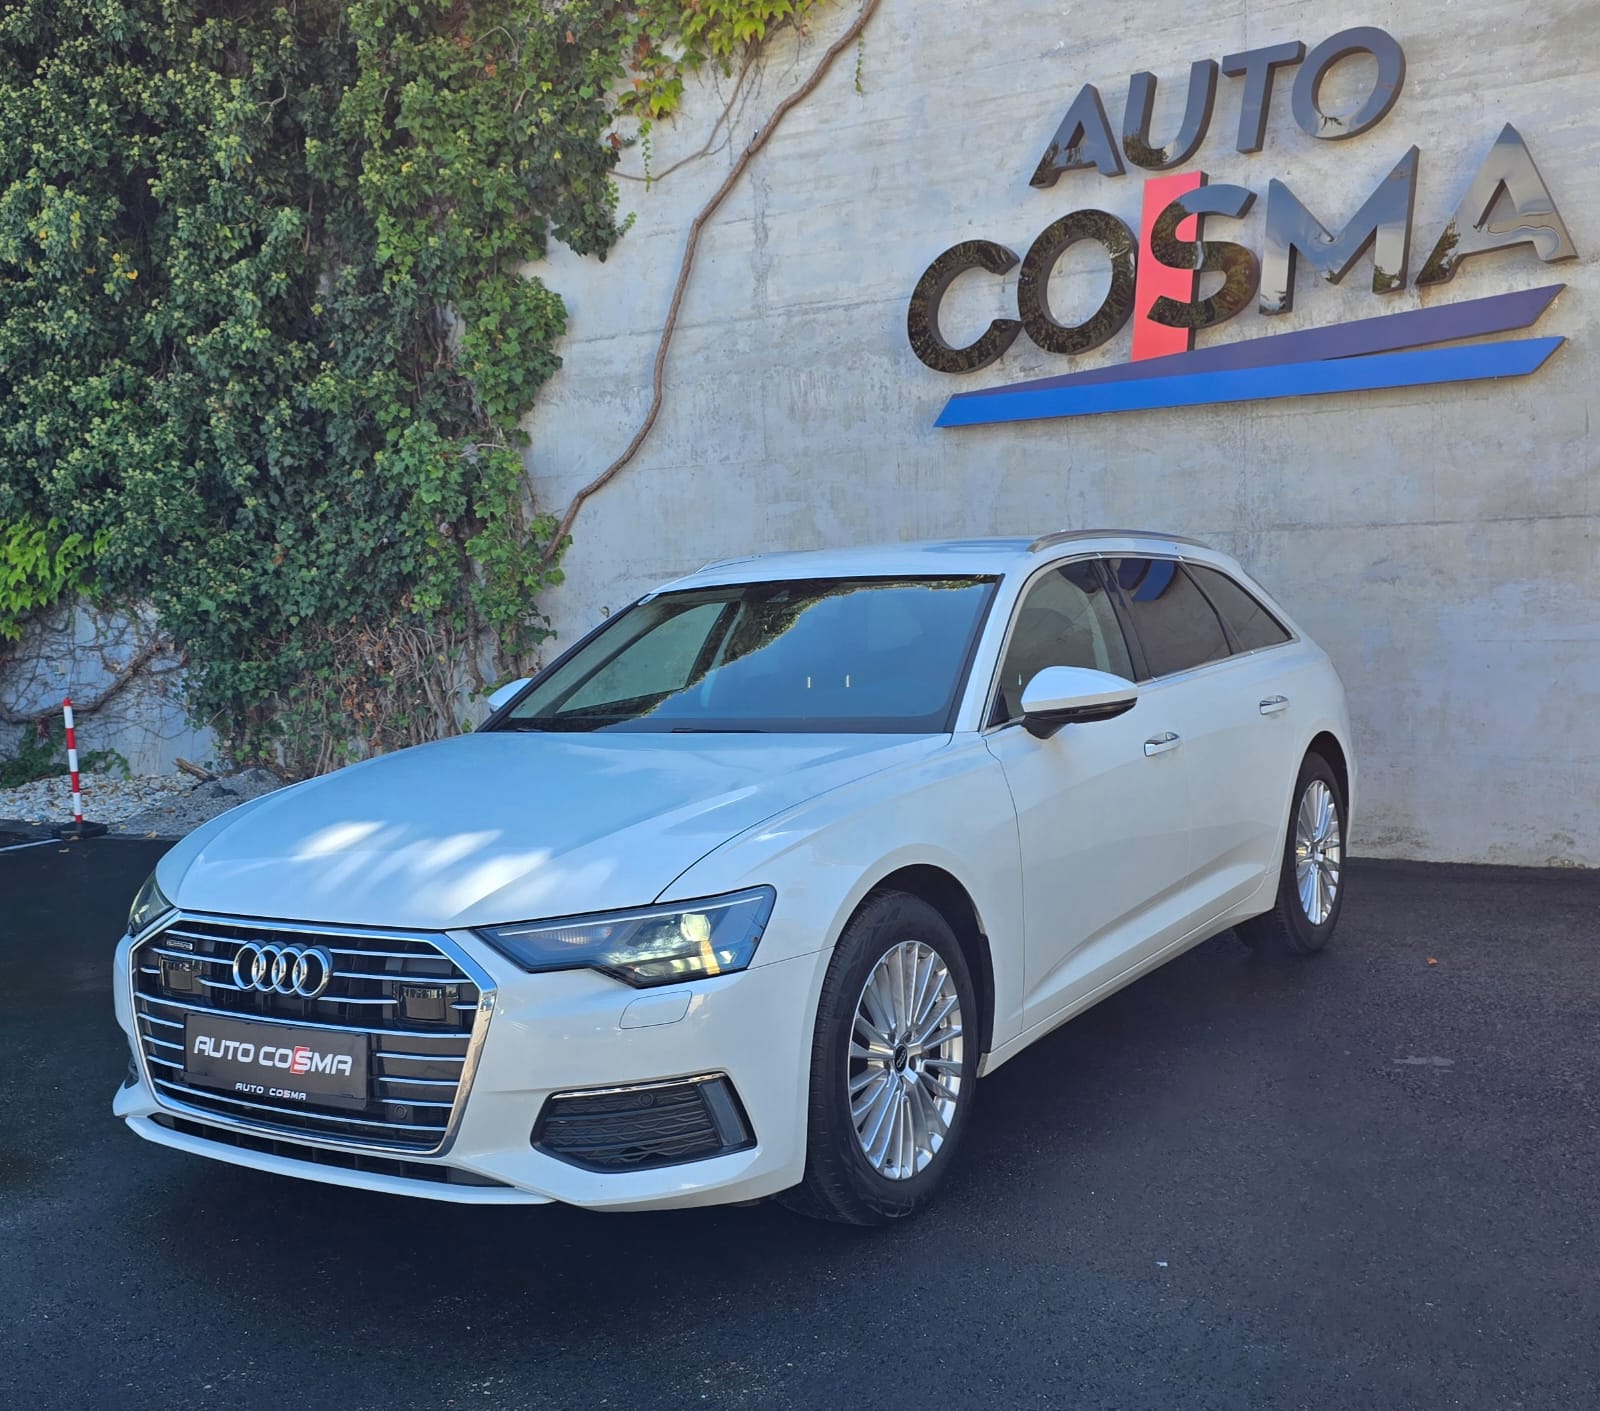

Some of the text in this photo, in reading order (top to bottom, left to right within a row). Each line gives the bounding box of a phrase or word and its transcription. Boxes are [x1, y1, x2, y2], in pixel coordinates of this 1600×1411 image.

[1028, 26, 1407, 189] AUTO
[907, 122, 1579, 374] COSMA
[193, 1036, 353, 1076] AUTO COSMA
[235, 1083, 307, 1100] AUTO COSMA
